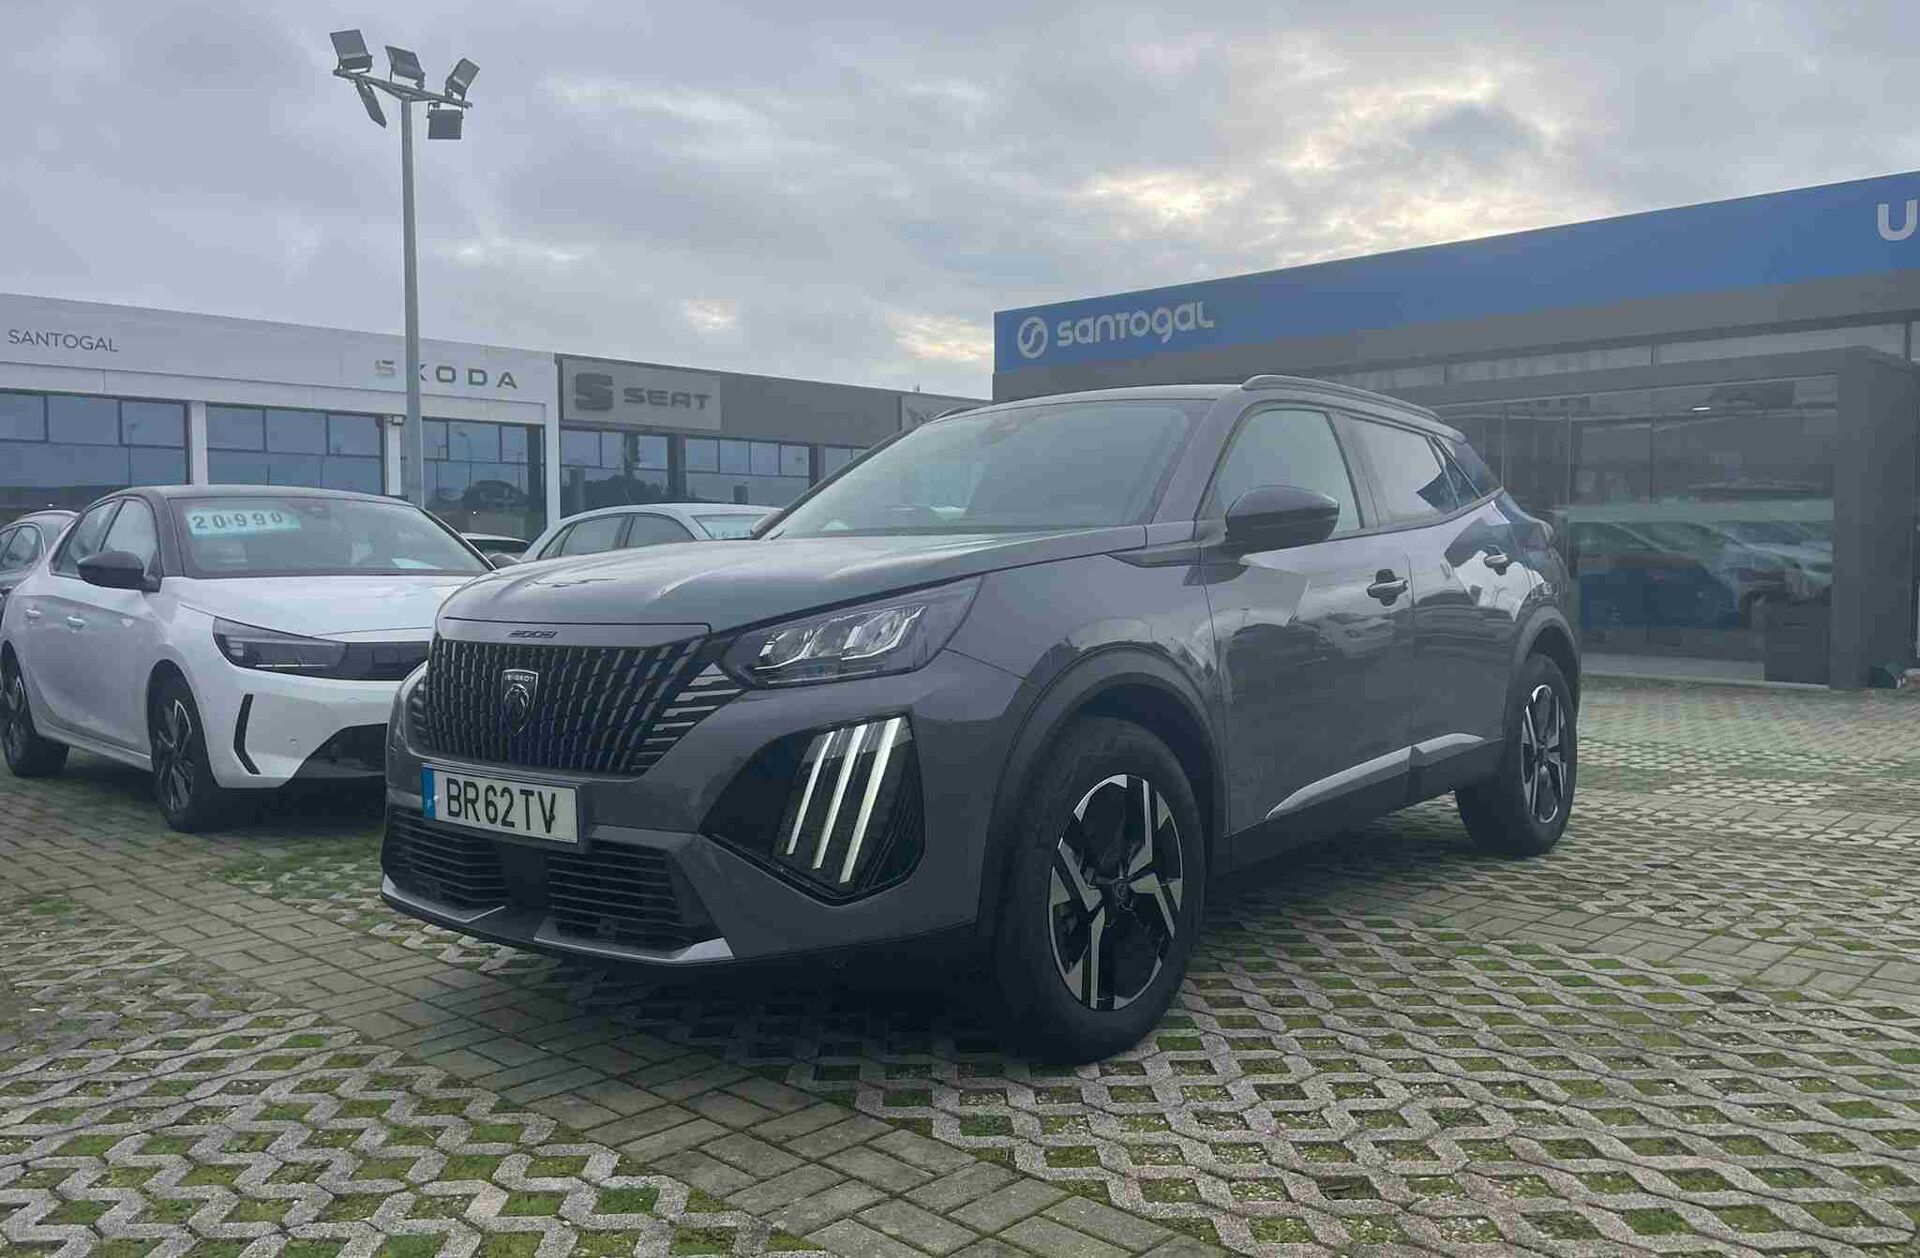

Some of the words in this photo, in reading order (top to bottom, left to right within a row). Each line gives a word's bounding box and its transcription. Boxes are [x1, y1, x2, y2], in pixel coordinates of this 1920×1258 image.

[8, 329, 119, 352] SANTOGAL
[623, 387, 711, 409] SEAT
[446, 777, 556, 834] BR62TV
